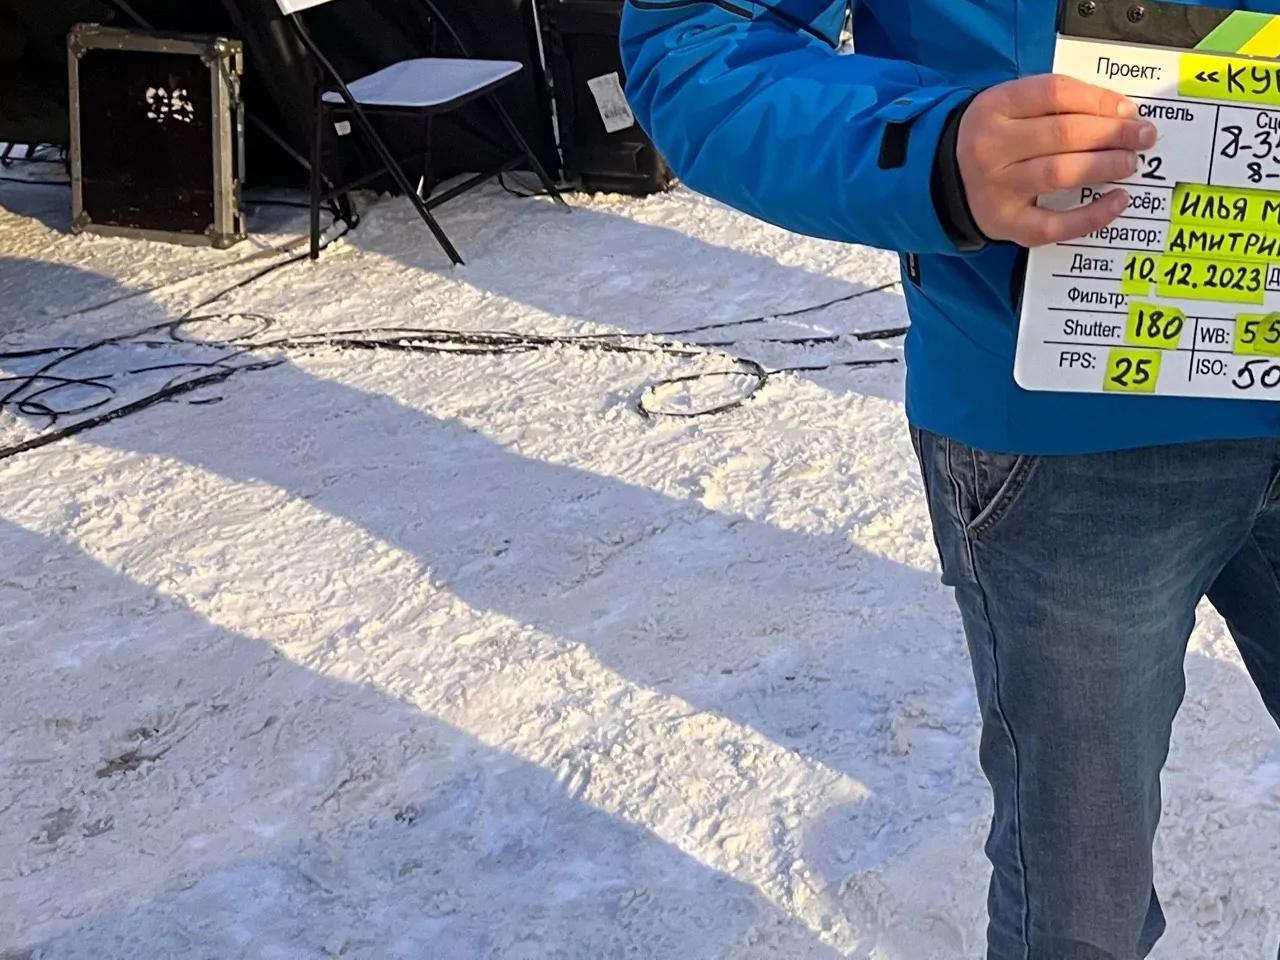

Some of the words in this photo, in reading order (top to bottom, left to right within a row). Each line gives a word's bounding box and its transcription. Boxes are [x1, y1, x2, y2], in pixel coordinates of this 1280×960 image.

[1096, 56, 1162, 81] Проект:
[1138, 102, 1195, 122] ситель
[1139, 154, 1166, 181] 2
[1179, 191, 1248, 222] ИЛЬЯ
[1070, 253, 1114, 274] Дата:
[1067, 286, 1128, 309] Фильтр:
[1063, 319, 1122, 338] Shutter:
[1134, 309, 1184, 340] 180
[1200, 327, 1230, 345] WB:
[1059, 351, 1097, 369] FPS:
[1195, 359, 1229, 377] ISO:
[1110, 357, 1152, 387] 25
